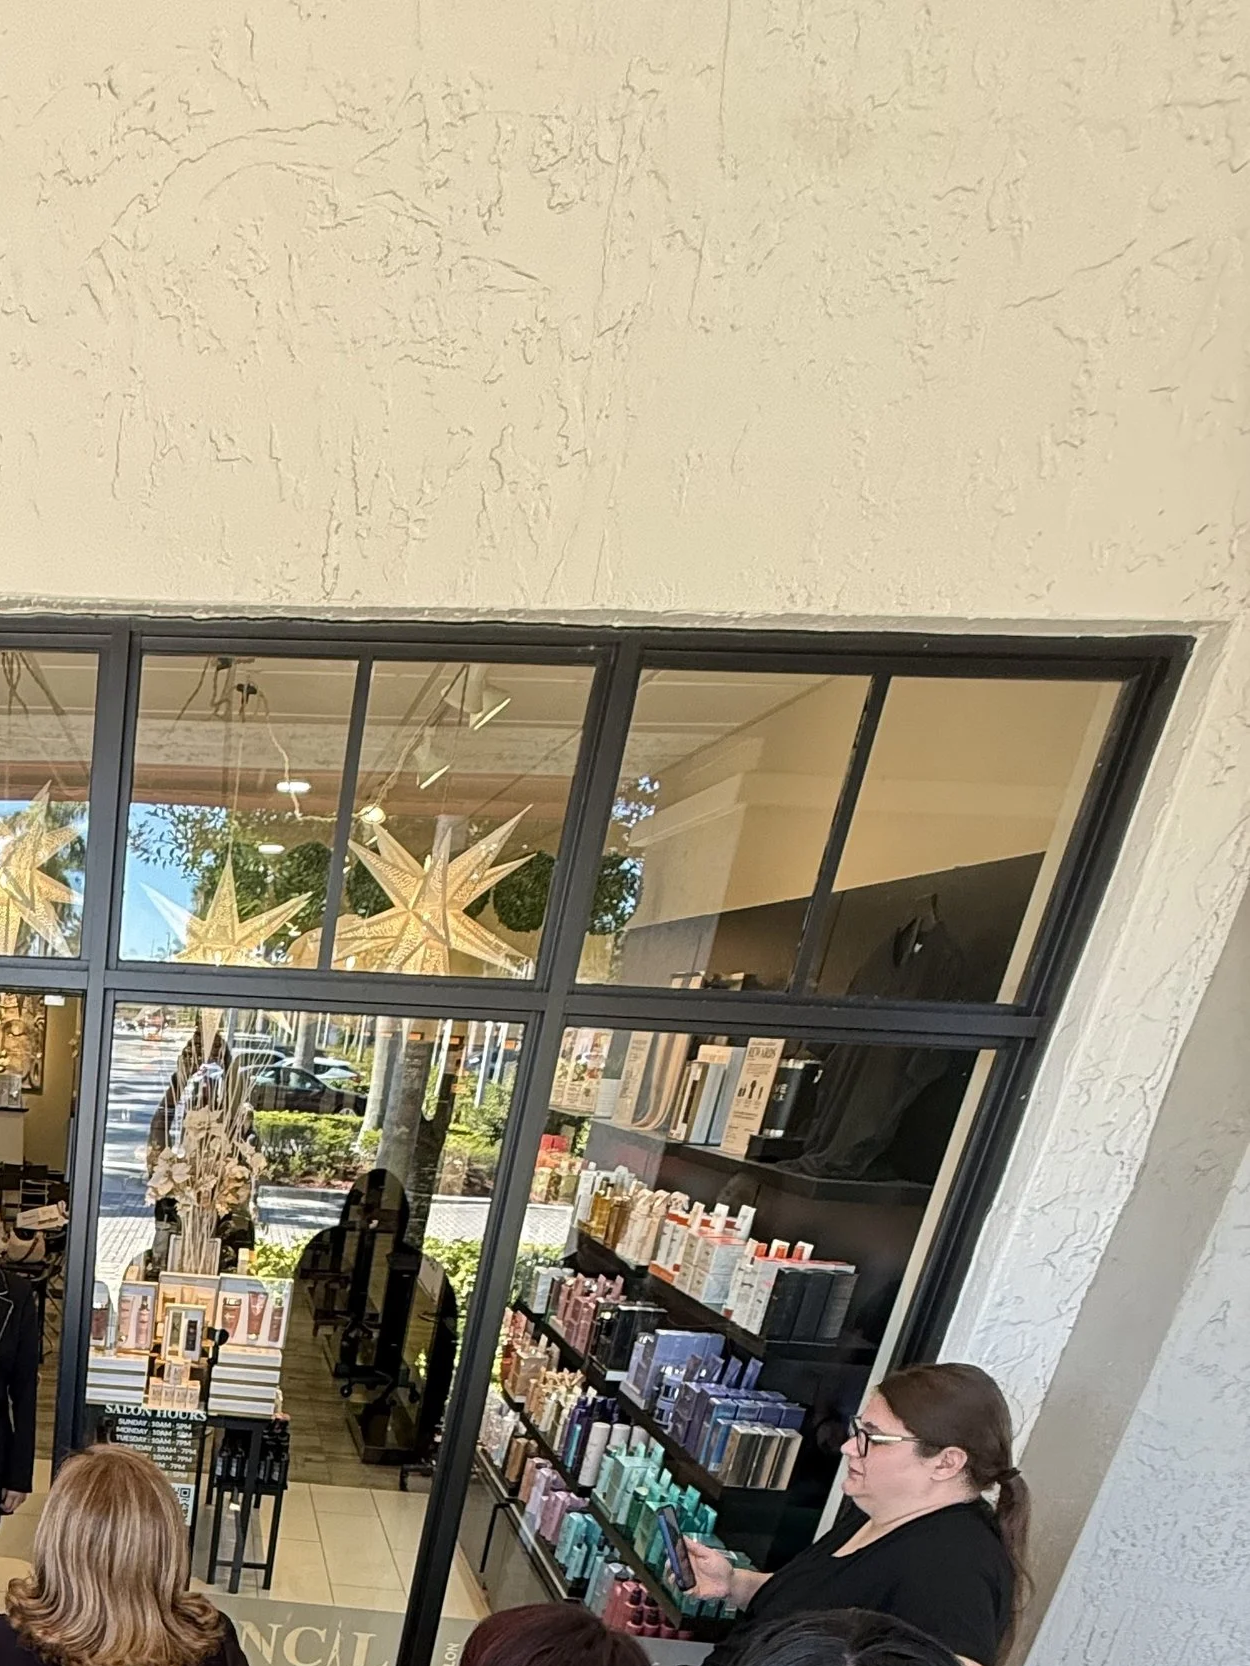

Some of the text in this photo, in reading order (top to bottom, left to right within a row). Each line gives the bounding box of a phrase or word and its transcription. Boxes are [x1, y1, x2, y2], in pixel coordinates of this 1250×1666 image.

[105, 1403, 207, 1422] SALON HOURS
[118, 1418, 148, 1426] SUNDAY
[116, 1426, 148, 1434] MONDAY
[115, 1434, 147, 1442] TUESDAY
